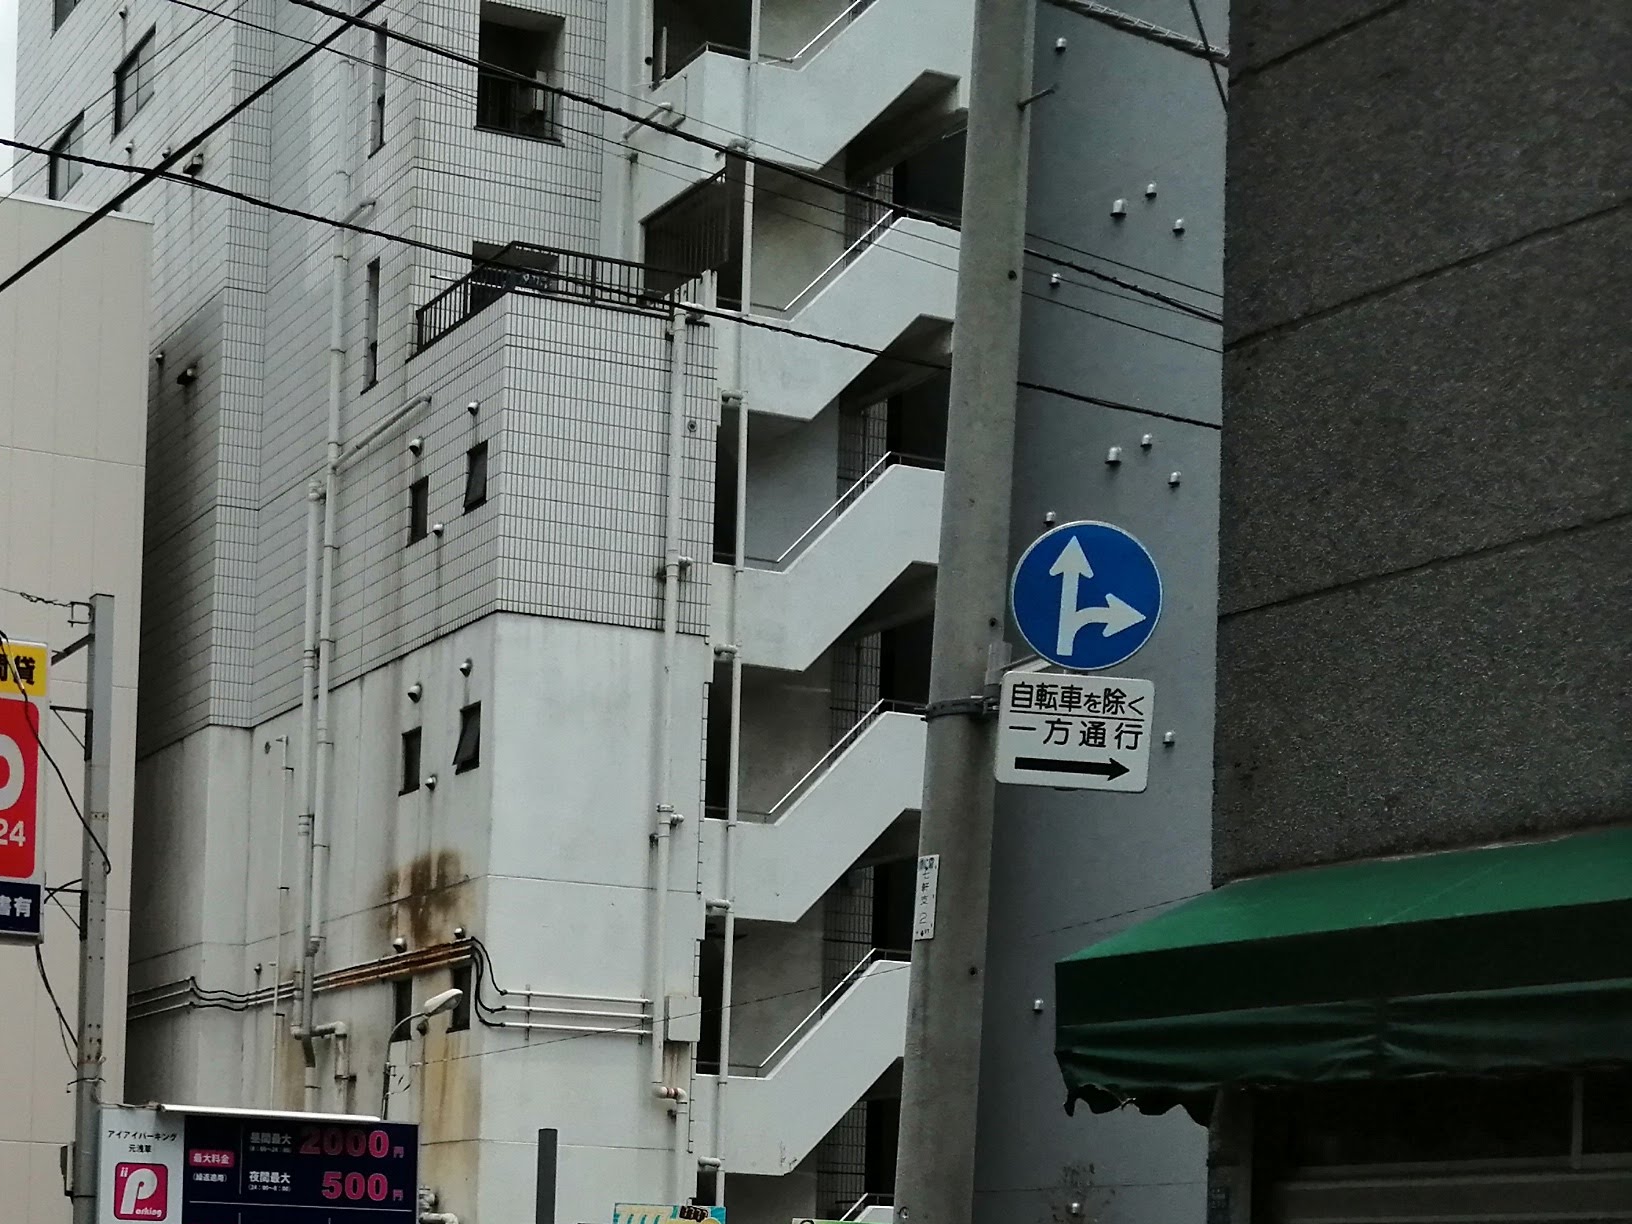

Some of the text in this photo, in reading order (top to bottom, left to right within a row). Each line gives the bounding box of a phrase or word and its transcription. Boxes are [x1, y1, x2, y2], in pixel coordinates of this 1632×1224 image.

[1010, 682, 1145, 716] 自転車を除く
[1008, 718, 1144, 751] 一方通行
[193, 1152, 230, 1165] 最大料金
[249, 1170, 291, 1184] 夜間最大
